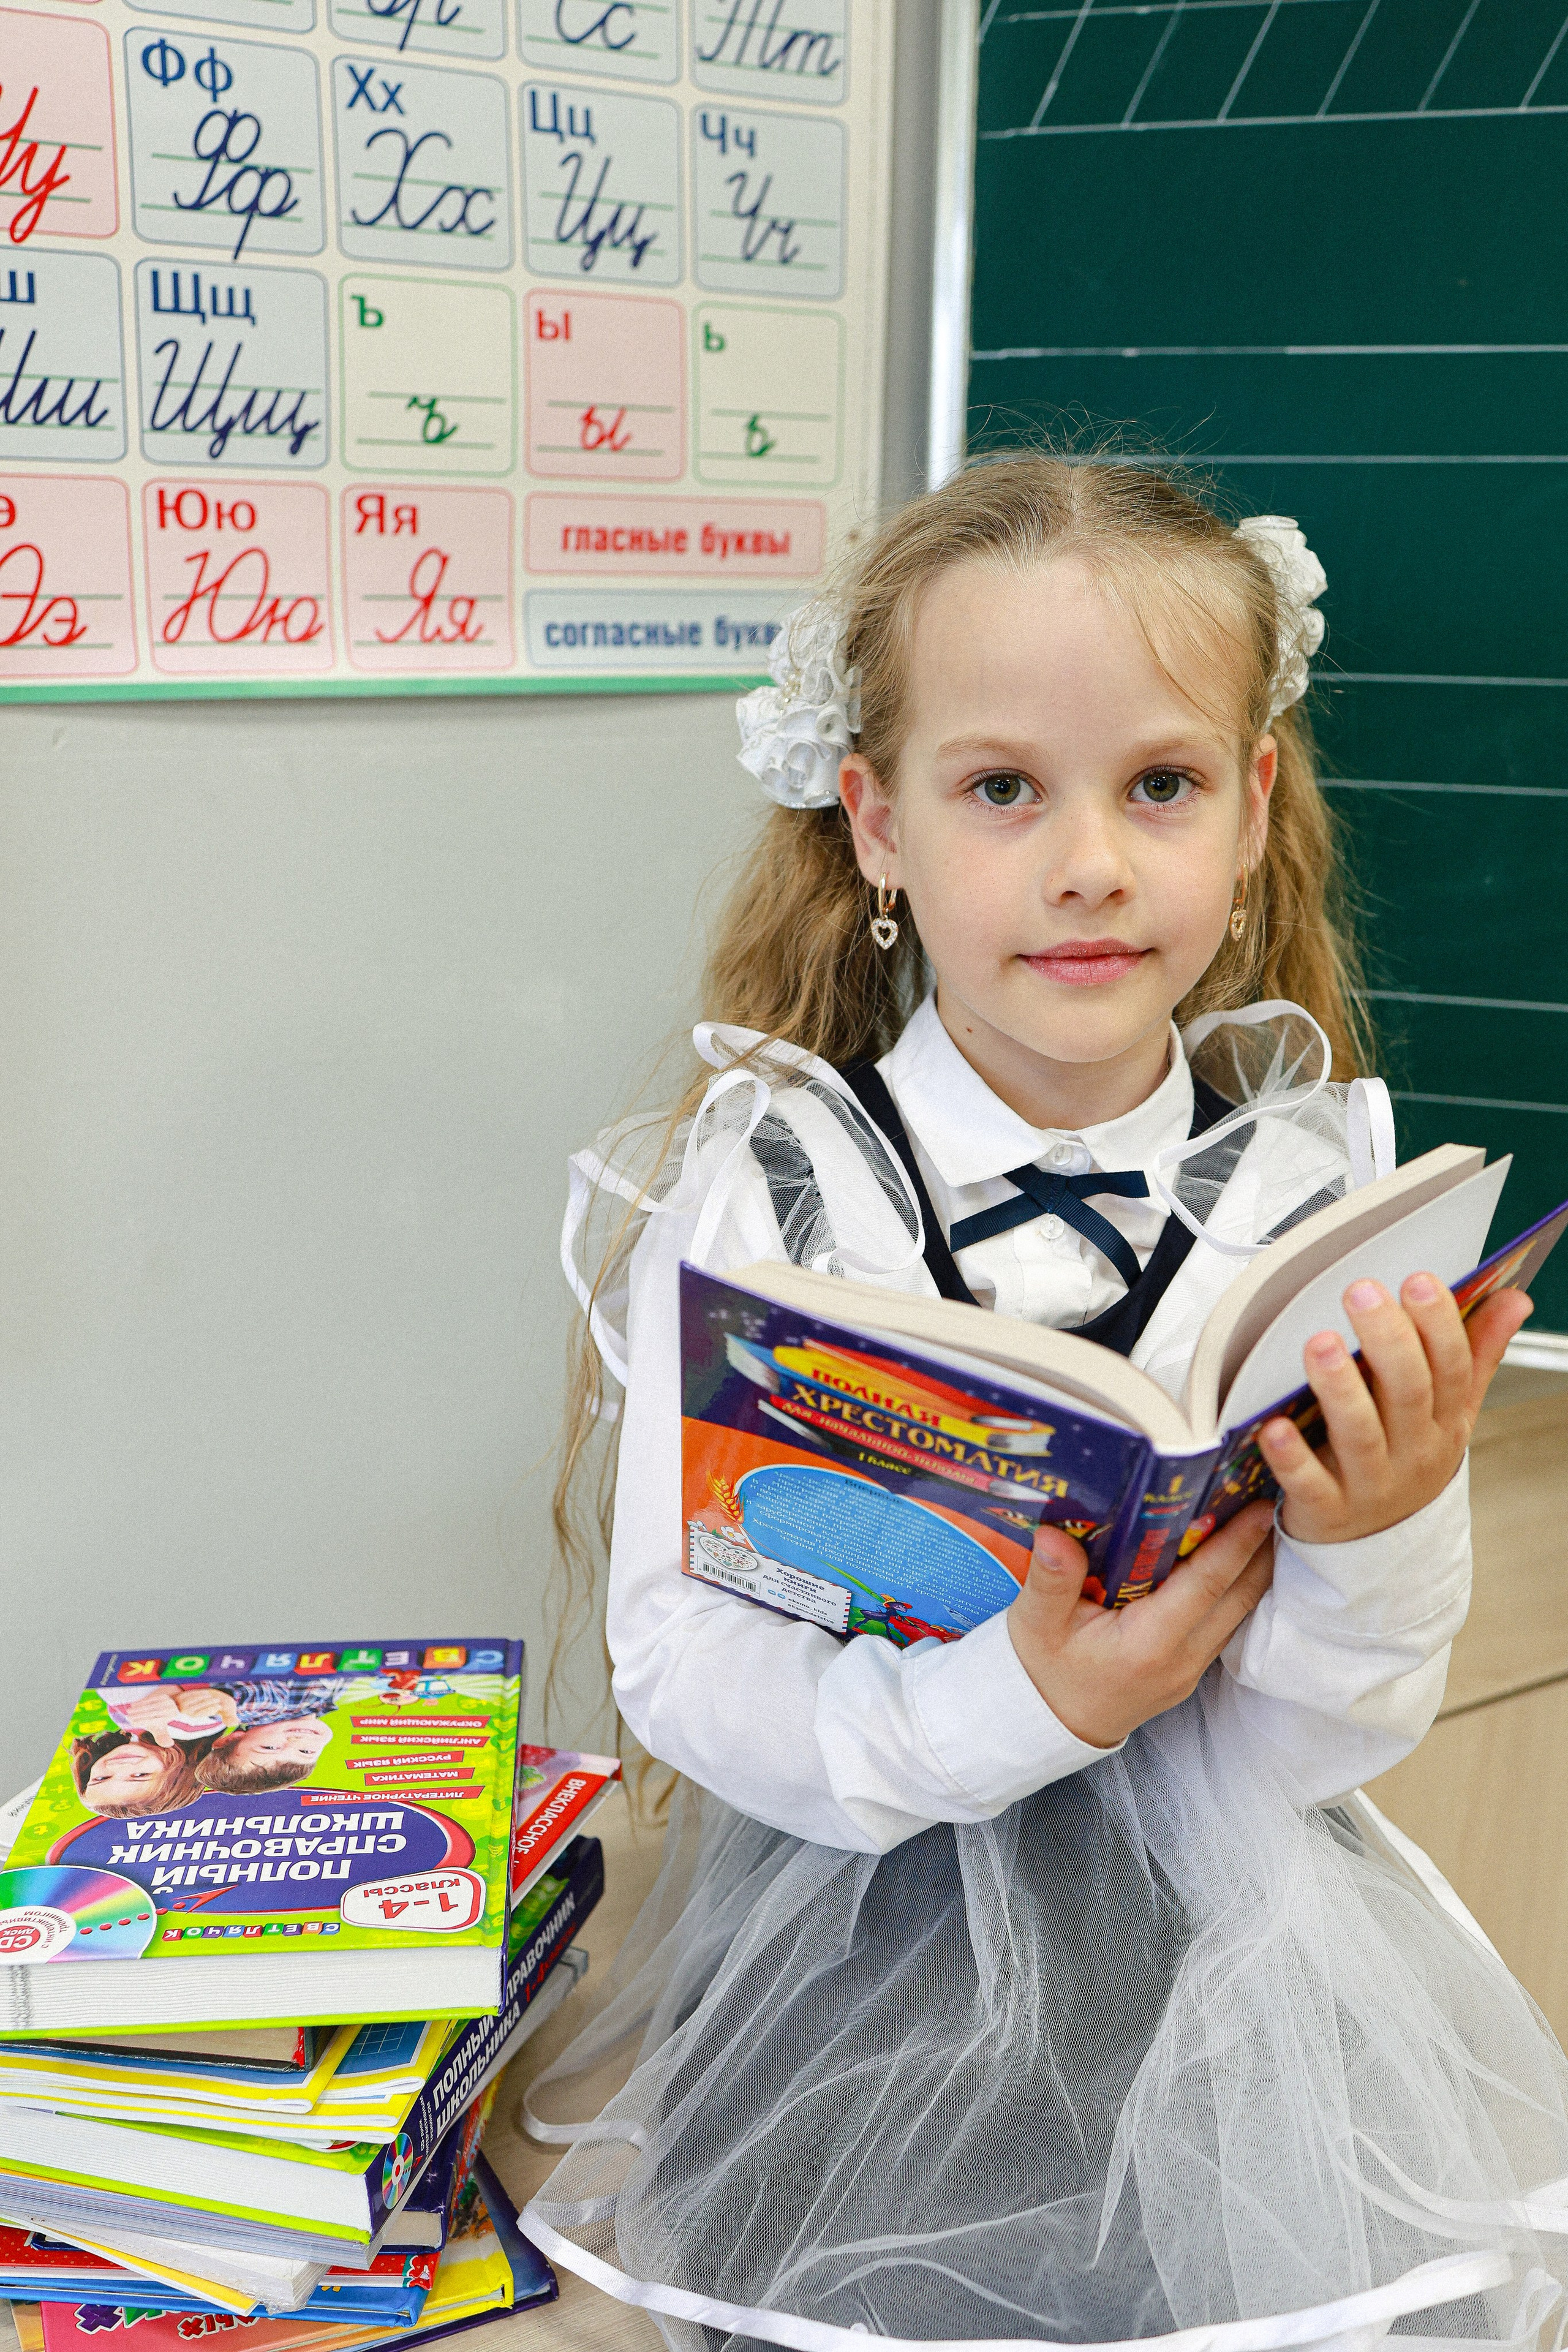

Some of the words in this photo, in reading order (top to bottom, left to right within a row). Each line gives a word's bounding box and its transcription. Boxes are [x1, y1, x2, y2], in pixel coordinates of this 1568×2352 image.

[560, 524, 688, 553] гласные
[701, 521, 793, 560] буквы
[545, 617, 703, 650] согласные
[810, 1368, 941, 1429] ПОЛНАЯ
[792, 1384, 1069, 1498] ХРЕСТОМАТИЯ
[755, 1491, 790, 1509] вошли
[752, 1517, 815, 1547] Хрестоматия
[817, 1544, 894, 1577] предназначена
[895, 1575, 914, 1585] для
[754, 1502, 816, 1530] зарубежной
[821, 1529, 872, 1553] классики.
[874, 1549, 903, 1564] Наша
[905, 1562, 971, 1590] хрестоматия
[973, 1588, 1012, 1605] поможе
[758, 1510, 832, 1542] сформировать
[888, 1561, 930, 1580] интерес
[941, 1581, 981, 1599] чтению
[770, 1504, 838, 1533] современной
[839, 1531, 881, 1550] детской
[949, 1574, 993, 1593] русской
[775, 1567, 826, 1591] Хорошие
[778, 1534, 814, 1551] чтения
[824, 1553, 843, 1562] для
[845, 1560, 903, 1586] подготовки
[913, 1587, 952, 1605] урокам
[952, 1602, 983, 1616] дома.
[823, 1541, 880, 1567] расширить
[881, 1564, 900, 1574] его
[902, 1572, 951, 1594] кругозор.
[762, 1574, 780, 1584] для
[780, 1581, 837, 1607] счастливого
[780, 1586, 817, 1604] детства
[782, 1577, 817, 1593] книги
[786, 1602, 835, 1624] eksmodetstvo
[787, 1597, 828, 1616] eksmo_kids
[123, 1648, 505, 1678] СВЕТЛЯЧОК
[390, 1718, 483, 1727] ОКРУЖАЮЩИЙ
[398, 1735, 482, 1745] АНГЛИЙСКИЙ
[353, 1758, 391, 1768] ЯЗЫК
[393, 1754, 453, 1766] РУССКИЙ
[371, 1771, 459, 1782] МАТЕМАТИКА
[363, 1791, 465, 1801] ЛИТЕРАТУРНОЕ
[126, 1811, 405, 1840] ШКОЛЬНИКА
[106, 1833, 407, 1865] СПРАВОЧНИК
[150, 1858, 352, 1895] ПОЛНЫЙ
[363, 1878, 461, 1898] классы
[162, 1922, 341, 1941] СВЕТЛЯЧОК
[505, 1891, 576, 2007] ПРАВОЧНИК
[436, 2000, 521, 2139] ШКОЛЬНИКА
[419, 2095, 430, 2155] ИНТЕРАКТИВНЫМ
